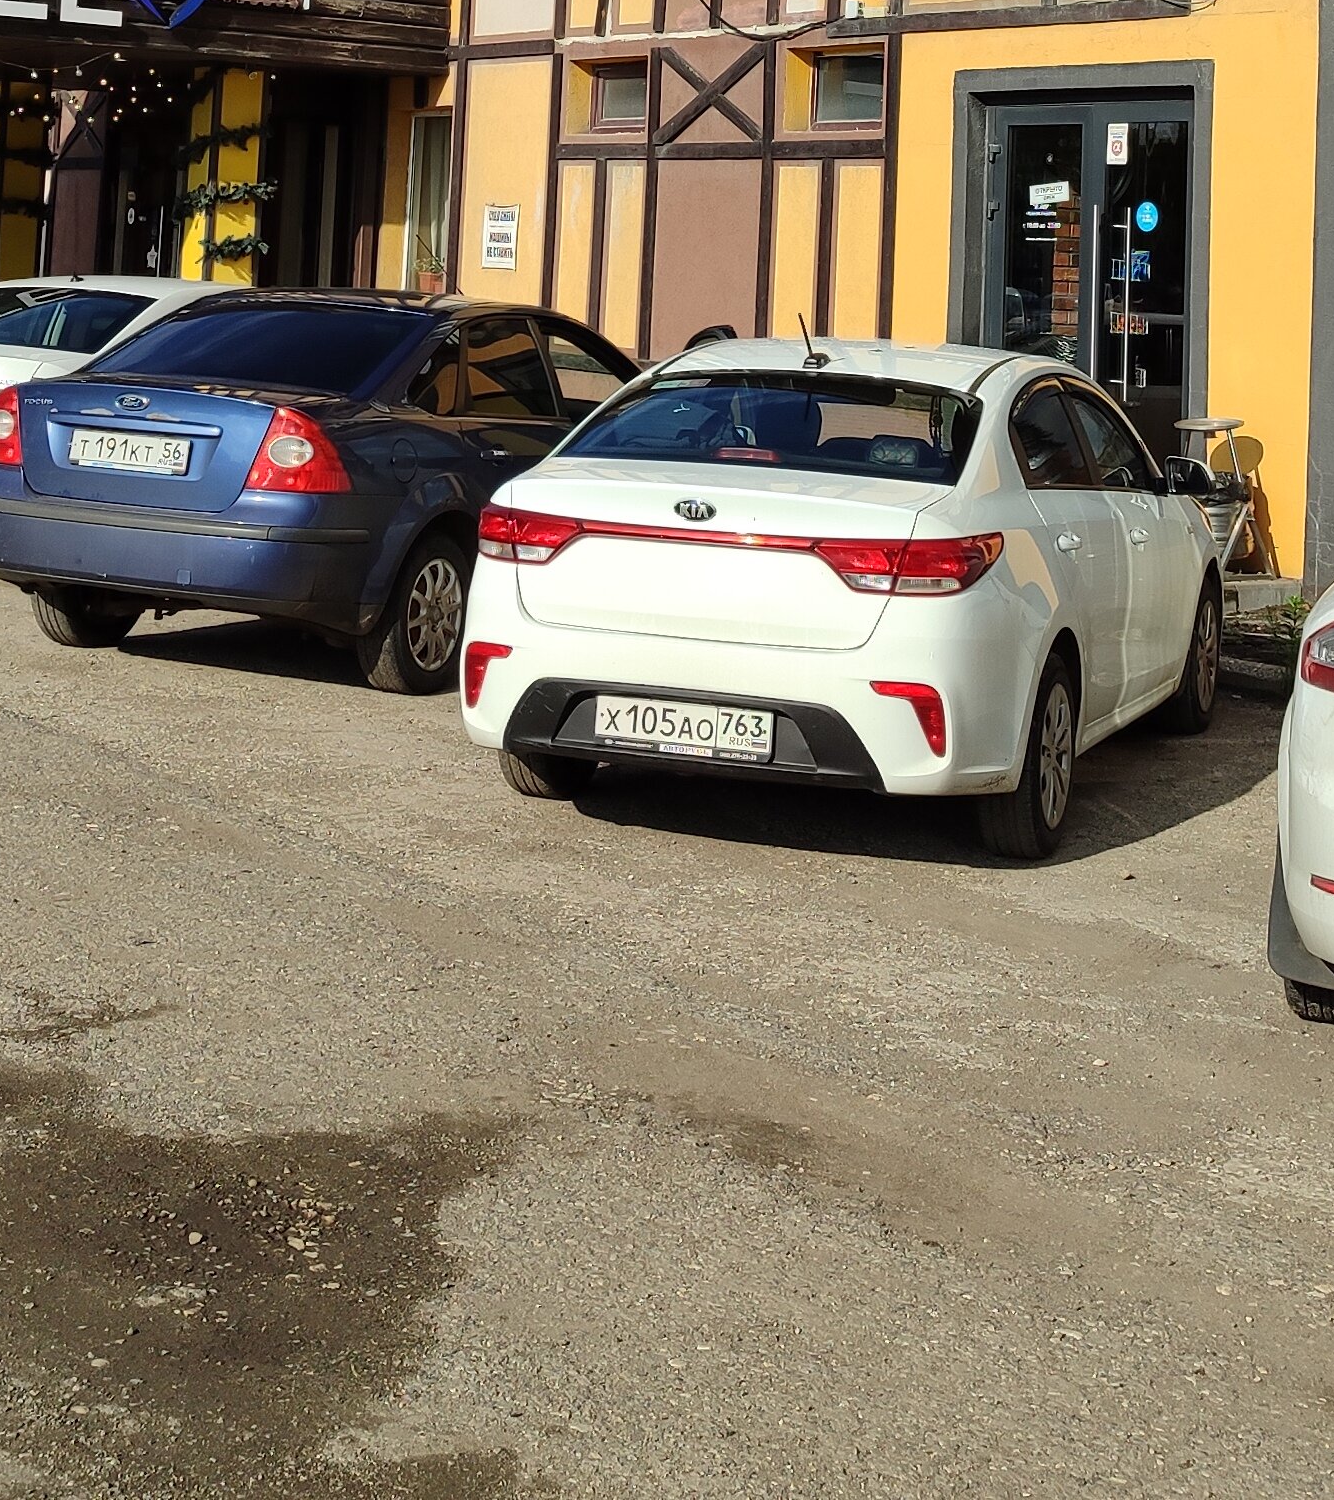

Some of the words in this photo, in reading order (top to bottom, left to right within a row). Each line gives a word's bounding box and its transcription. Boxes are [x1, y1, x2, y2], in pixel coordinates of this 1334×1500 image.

[163, 442, 182, 461] 56
[679, 502, 709, 518] KIA
[604, 704, 714, 741] Х105АО
[721, 712, 764, 738] 763
[728, 736, 751, 747] RUS
